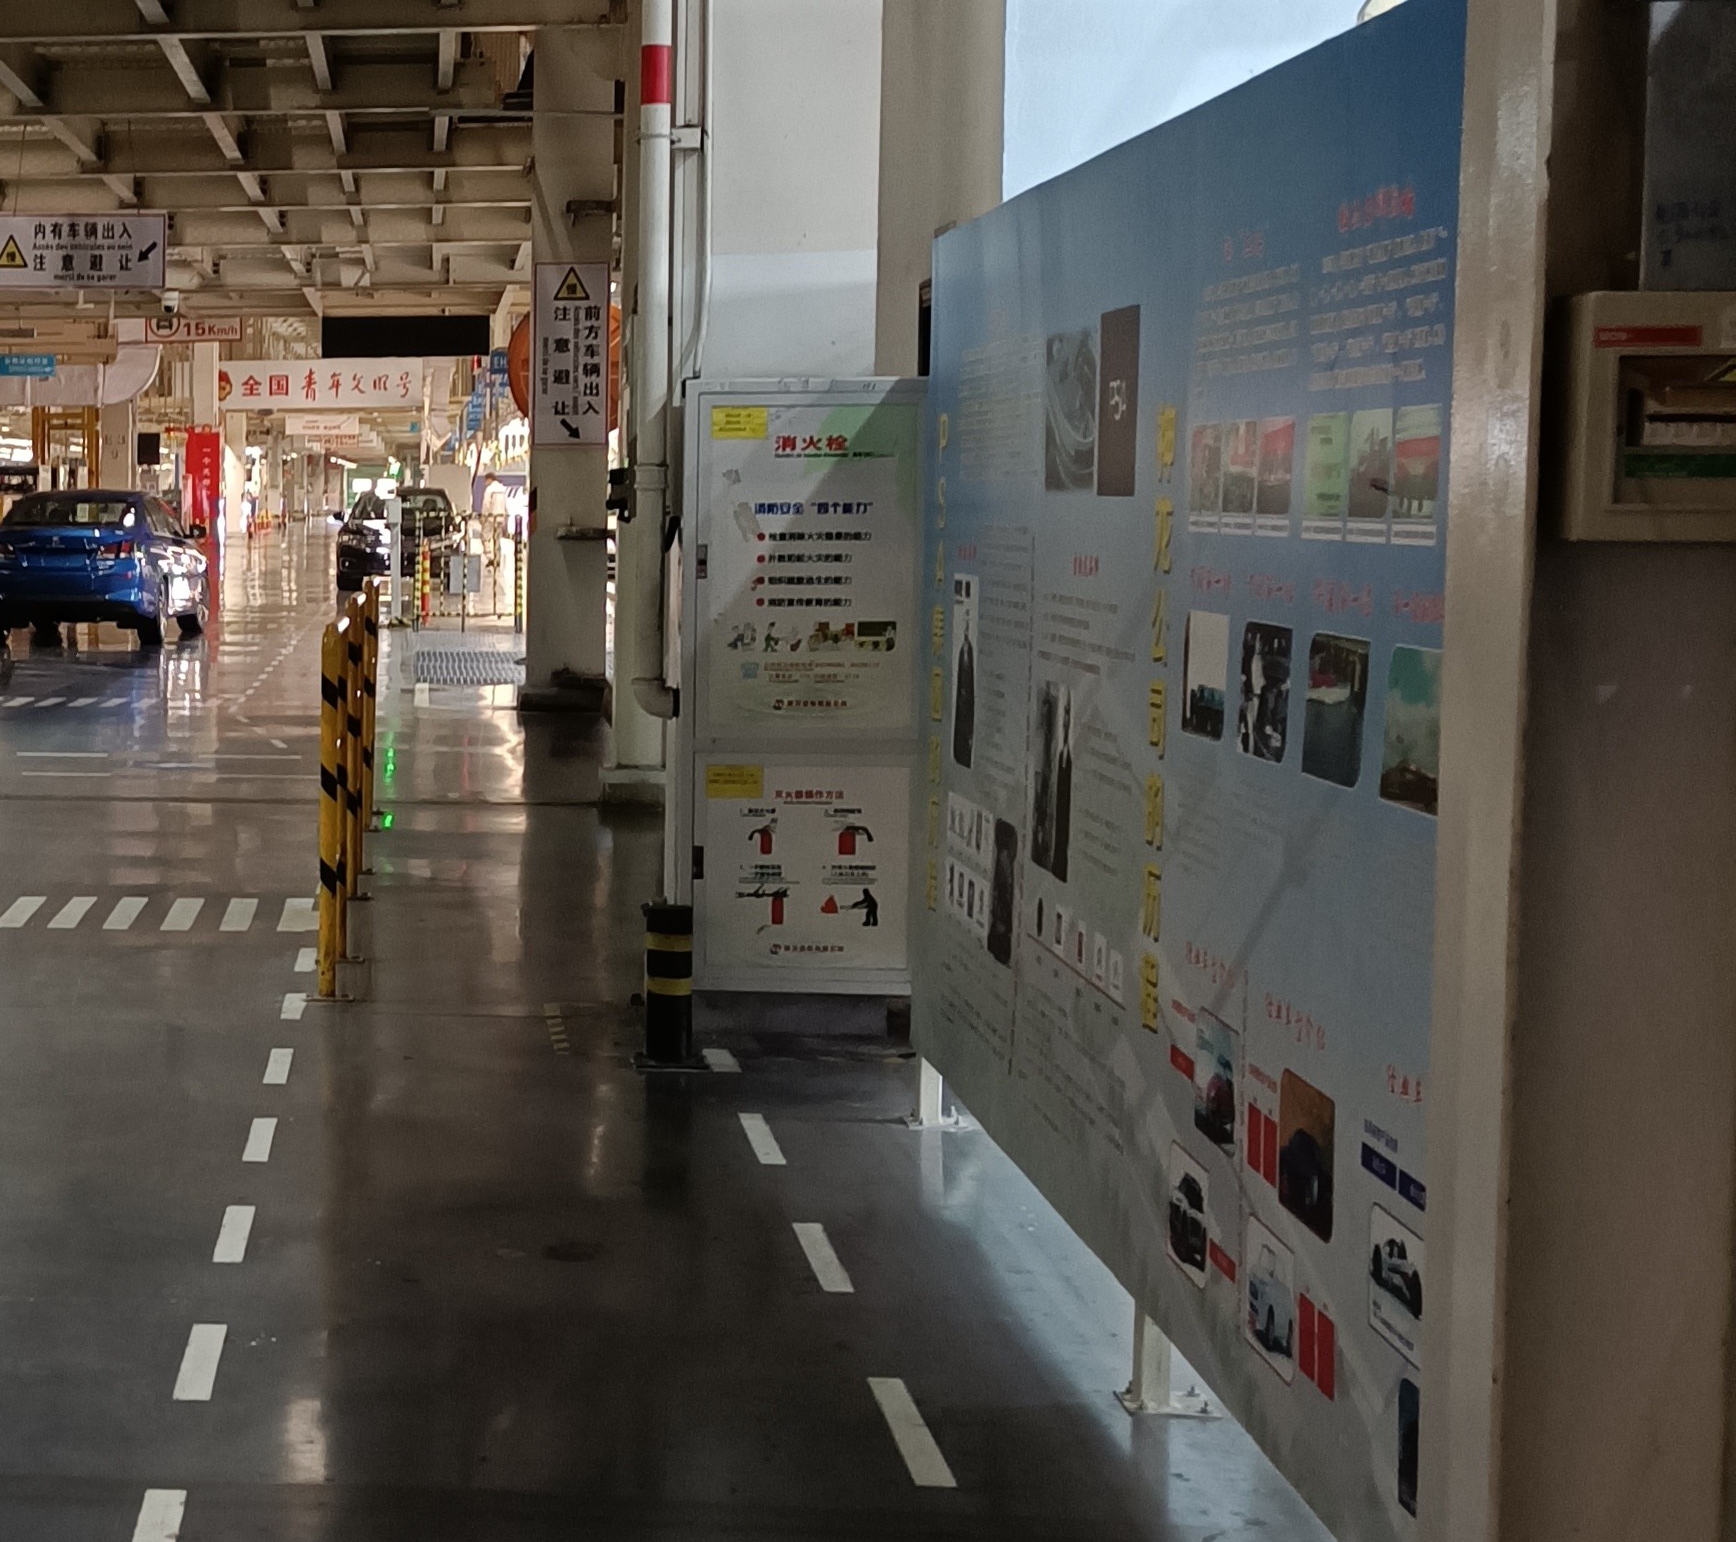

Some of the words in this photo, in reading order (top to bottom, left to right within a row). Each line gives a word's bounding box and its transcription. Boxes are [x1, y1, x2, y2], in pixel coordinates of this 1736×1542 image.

[33, 221, 132, 241] 内有车辆出入
[33, 253, 132, 272] 注意避让
[552, 306, 571, 416] 注意避让
[582, 305, 601, 416] 前方车辆出入
[241, 366, 413, 402] 全国青年文明号
[774, 434, 848, 452] 消火栓
